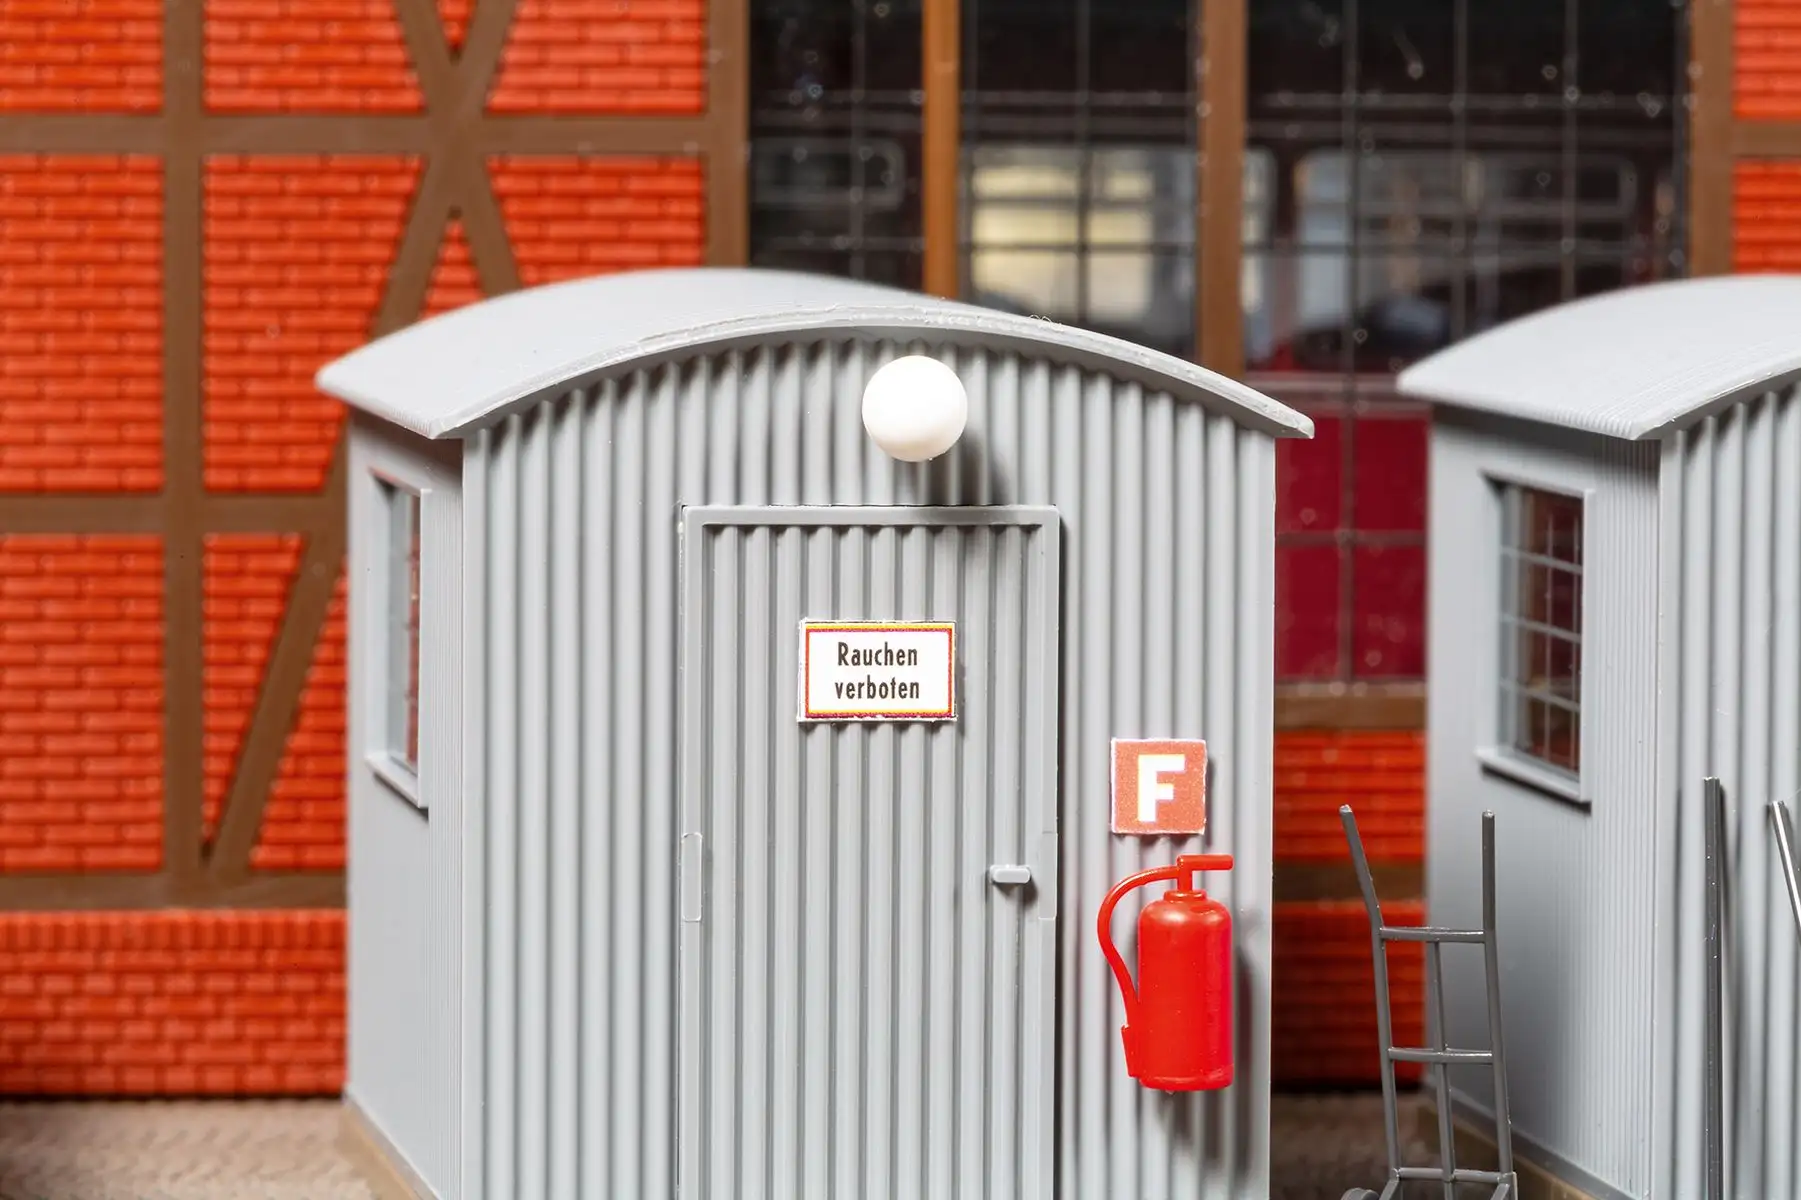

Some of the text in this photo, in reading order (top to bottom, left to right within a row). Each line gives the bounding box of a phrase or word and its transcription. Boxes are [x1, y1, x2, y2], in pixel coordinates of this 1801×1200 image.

[837, 641, 918, 667] Rauchen
[834, 674, 920, 700] verboten
[1137, 753, 1186, 823] F
